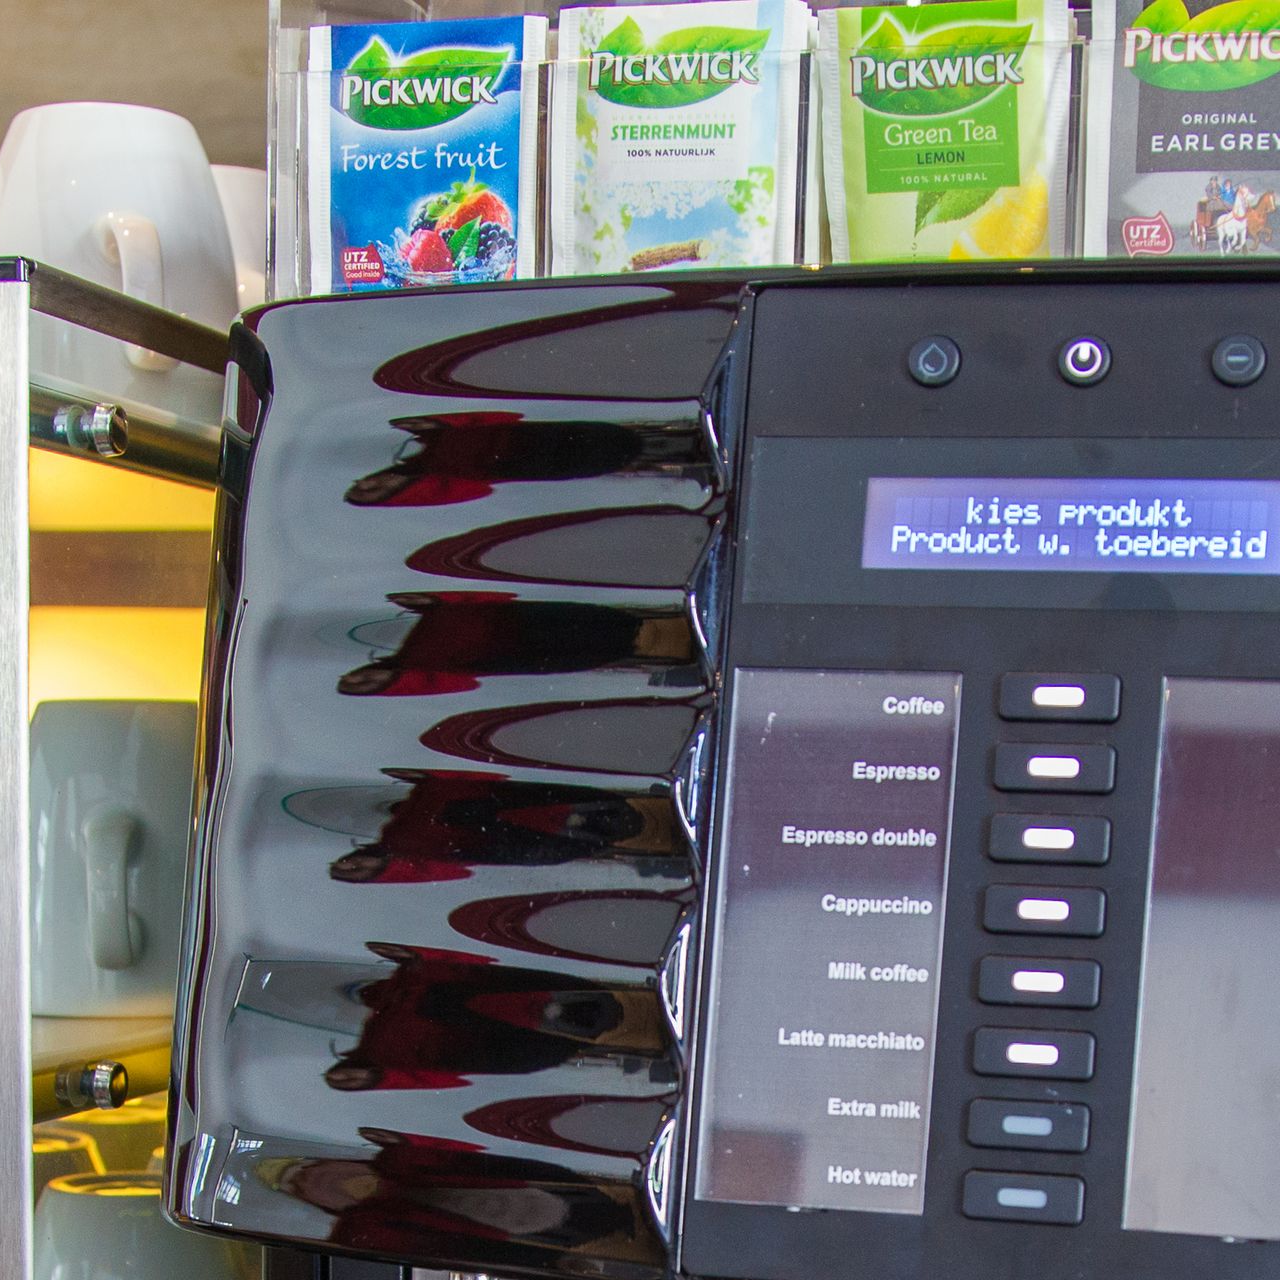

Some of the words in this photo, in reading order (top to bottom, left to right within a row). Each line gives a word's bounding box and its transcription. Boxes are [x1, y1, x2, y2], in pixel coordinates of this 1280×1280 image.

[589, 50, 760, 89] PICKWICK
[851, 52, 1024, 96] PICKWICK
[342, 73, 499, 110] PICKWICK
[1182, 112, 1258, 126] ORIGINAL
[611, 123, 736, 141] STERRENMUNT
[884, 122, 952, 146] Green
[958, 119, 998, 142] Tea
[627, 149, 652, 157] 100%
[655, 148, 715, 156] NATUURLIJK
[1151, 134, 1214, 153] EARL
[341, 144, 426, 173] Forest
[434, 140, 507, 171] fruit
[916, 150, 966, 165] LEMON
[900, 175, 929, 185] 100%
[934, 172, 988, 184] NATURAL
[1129, 224, 1161, 239] UTZ
[343, 251, 369, 263] UTZ
[344, 262, 380, 271] CERTIFIED
[966, 496, 1042, 526] kies
[1059, 499, 1192, 528] produkt
[890, 527, 1020, 555] Product
[1037, 534, 1071, 556] w.
[1095, 528, 1267, 559] toebereid
[882, 697, 945, 716] Coffee
[852, 762, 941, 784] Espresso
[782, 826, 868, 848] Espresso
[872, 827, 937, 848] double
[821, 894, 933, 919] Cappuccino
[828, 962, 867, 981] Milk
[870, 964, 929, 983] coffee
[778, 1027, 825, 1047] Latte
[828, 1030, 925, 1051] macchiato
[828, 1098, 876, 1117] Extra
[879, 1100, 921, 1119] milk
[827, 1166, 861, 1186] Hot
[863, 1169, 918, 1188] water
